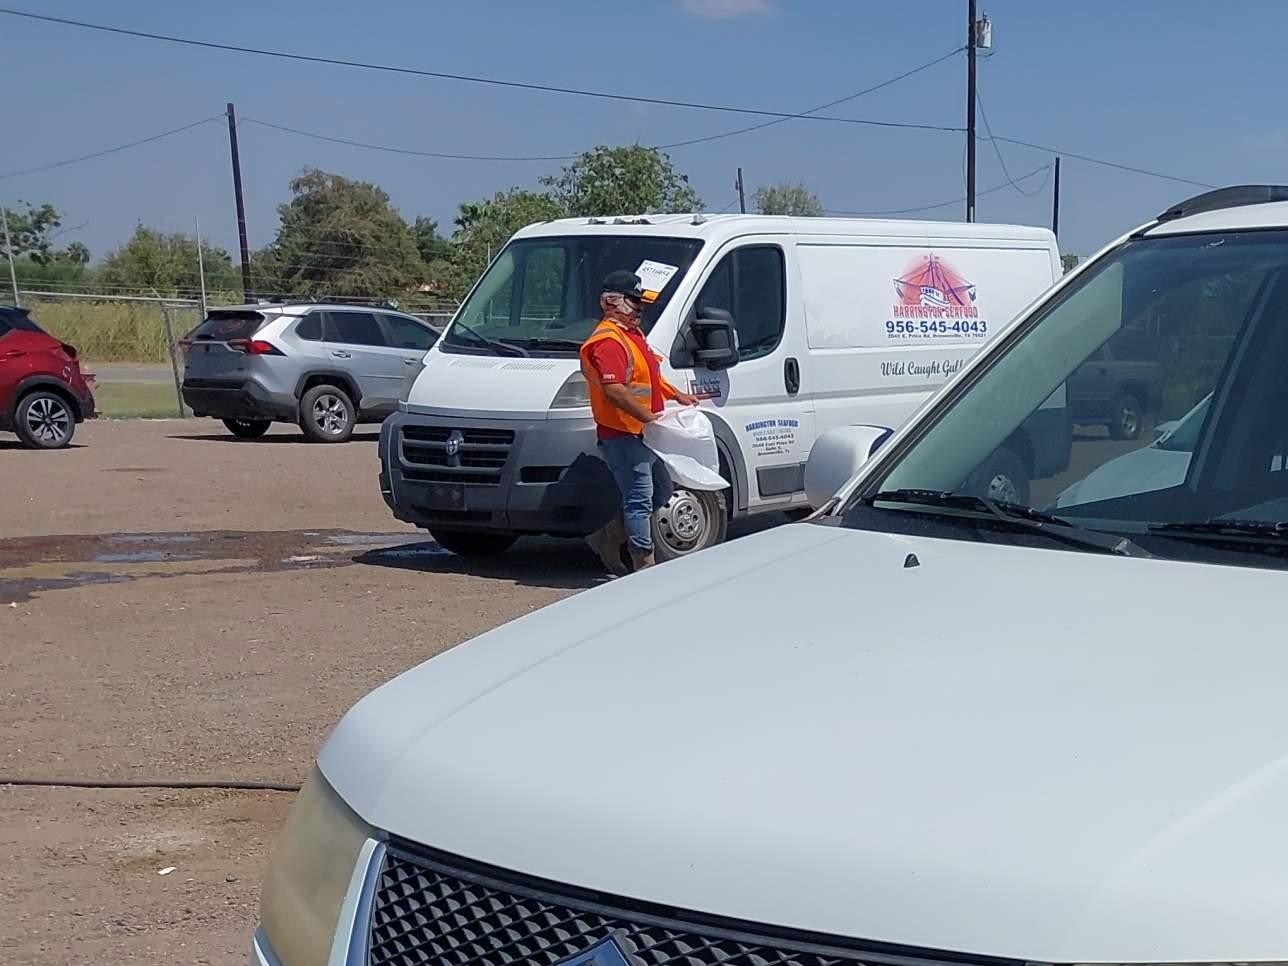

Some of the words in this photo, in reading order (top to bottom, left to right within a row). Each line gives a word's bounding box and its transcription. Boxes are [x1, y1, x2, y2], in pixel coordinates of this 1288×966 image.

[893, 305, 942, 318] HARRINGTON
[945, 306, 978, 318] SEAFOOD
[885, 320, 987, 333] 956-545-4043
[880, 361, 905, 376] Wild
[907, 360, 940, 378] Caught
